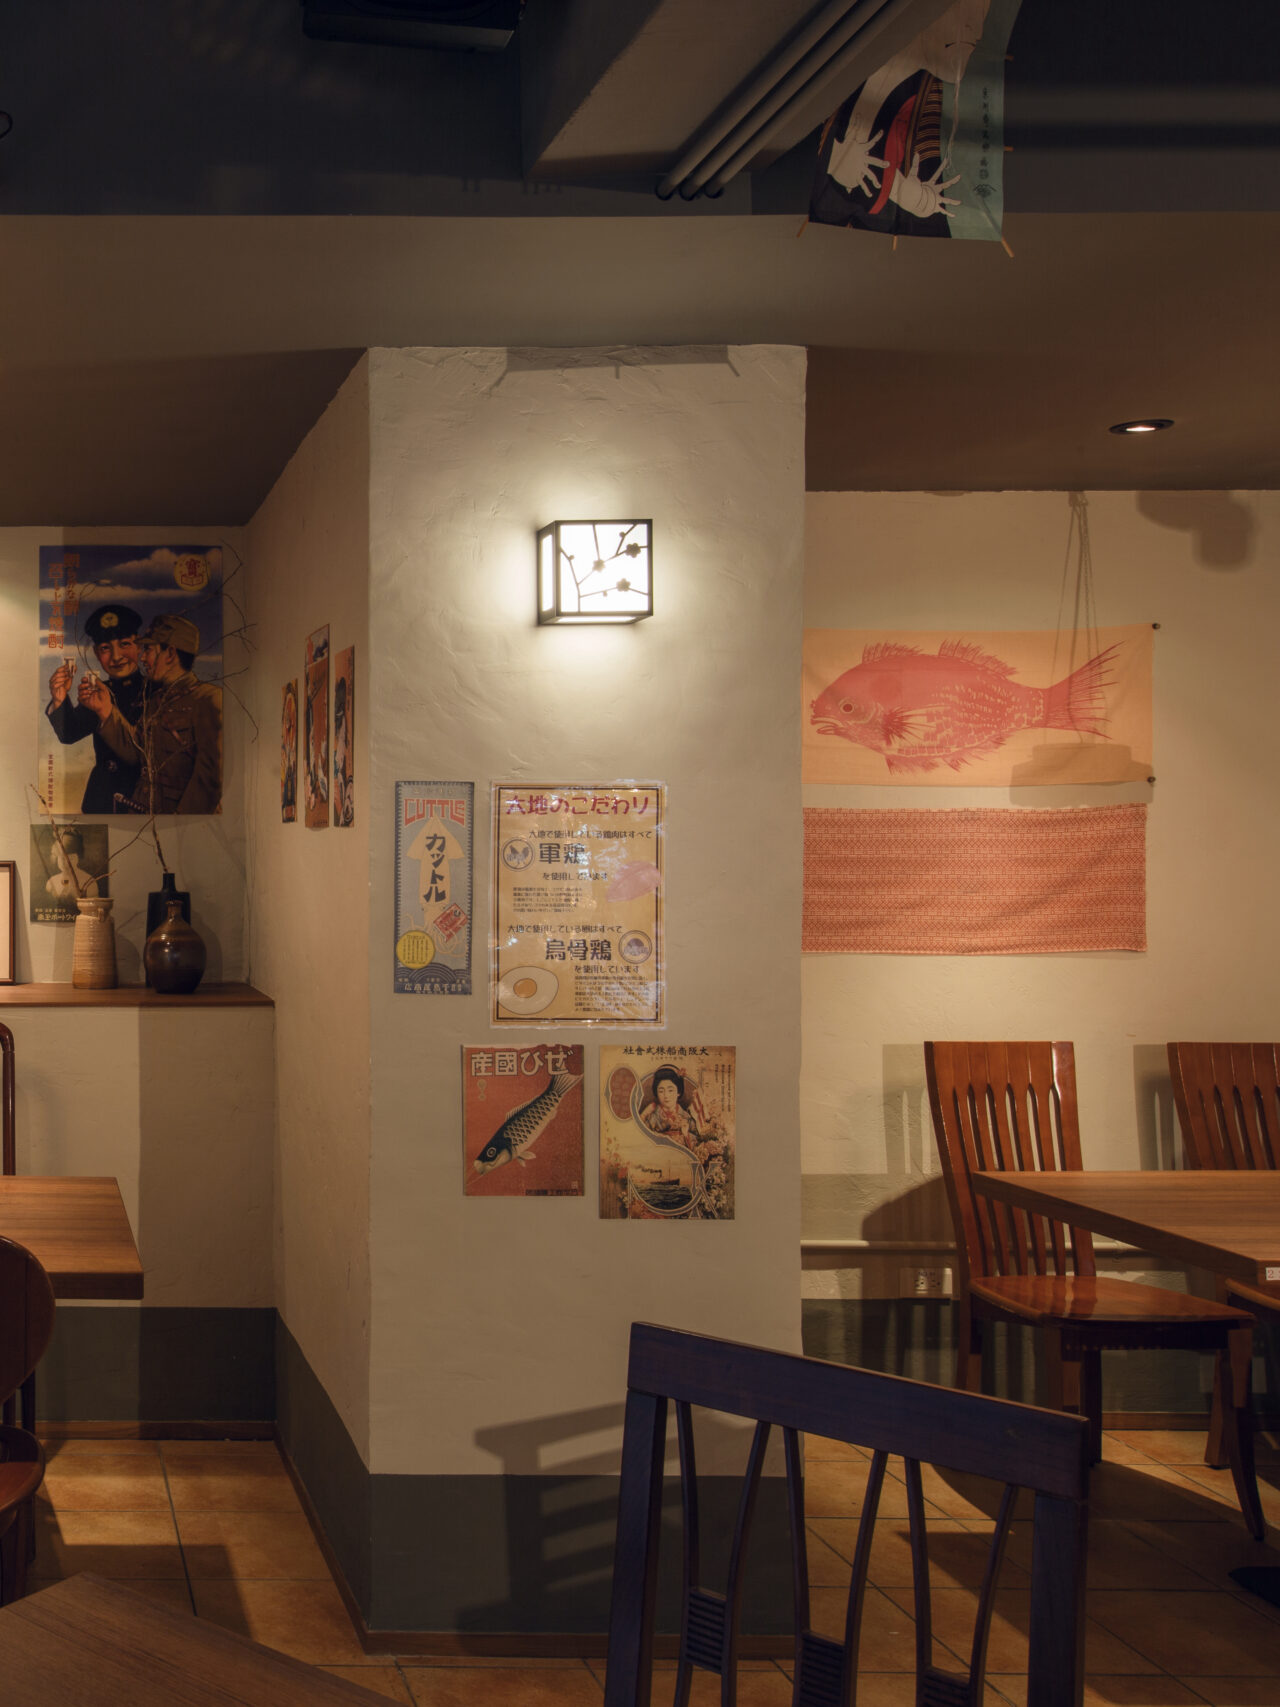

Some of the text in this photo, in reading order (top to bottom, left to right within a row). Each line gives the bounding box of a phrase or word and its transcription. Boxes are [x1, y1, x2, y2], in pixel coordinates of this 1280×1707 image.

[403, 798, 465, 827] CUTTLE
[505, 794, 650, 815] 大地のこだわり
[423, 833, 447, 903] カットル
[574, 965, 640, 974] を使用しています
